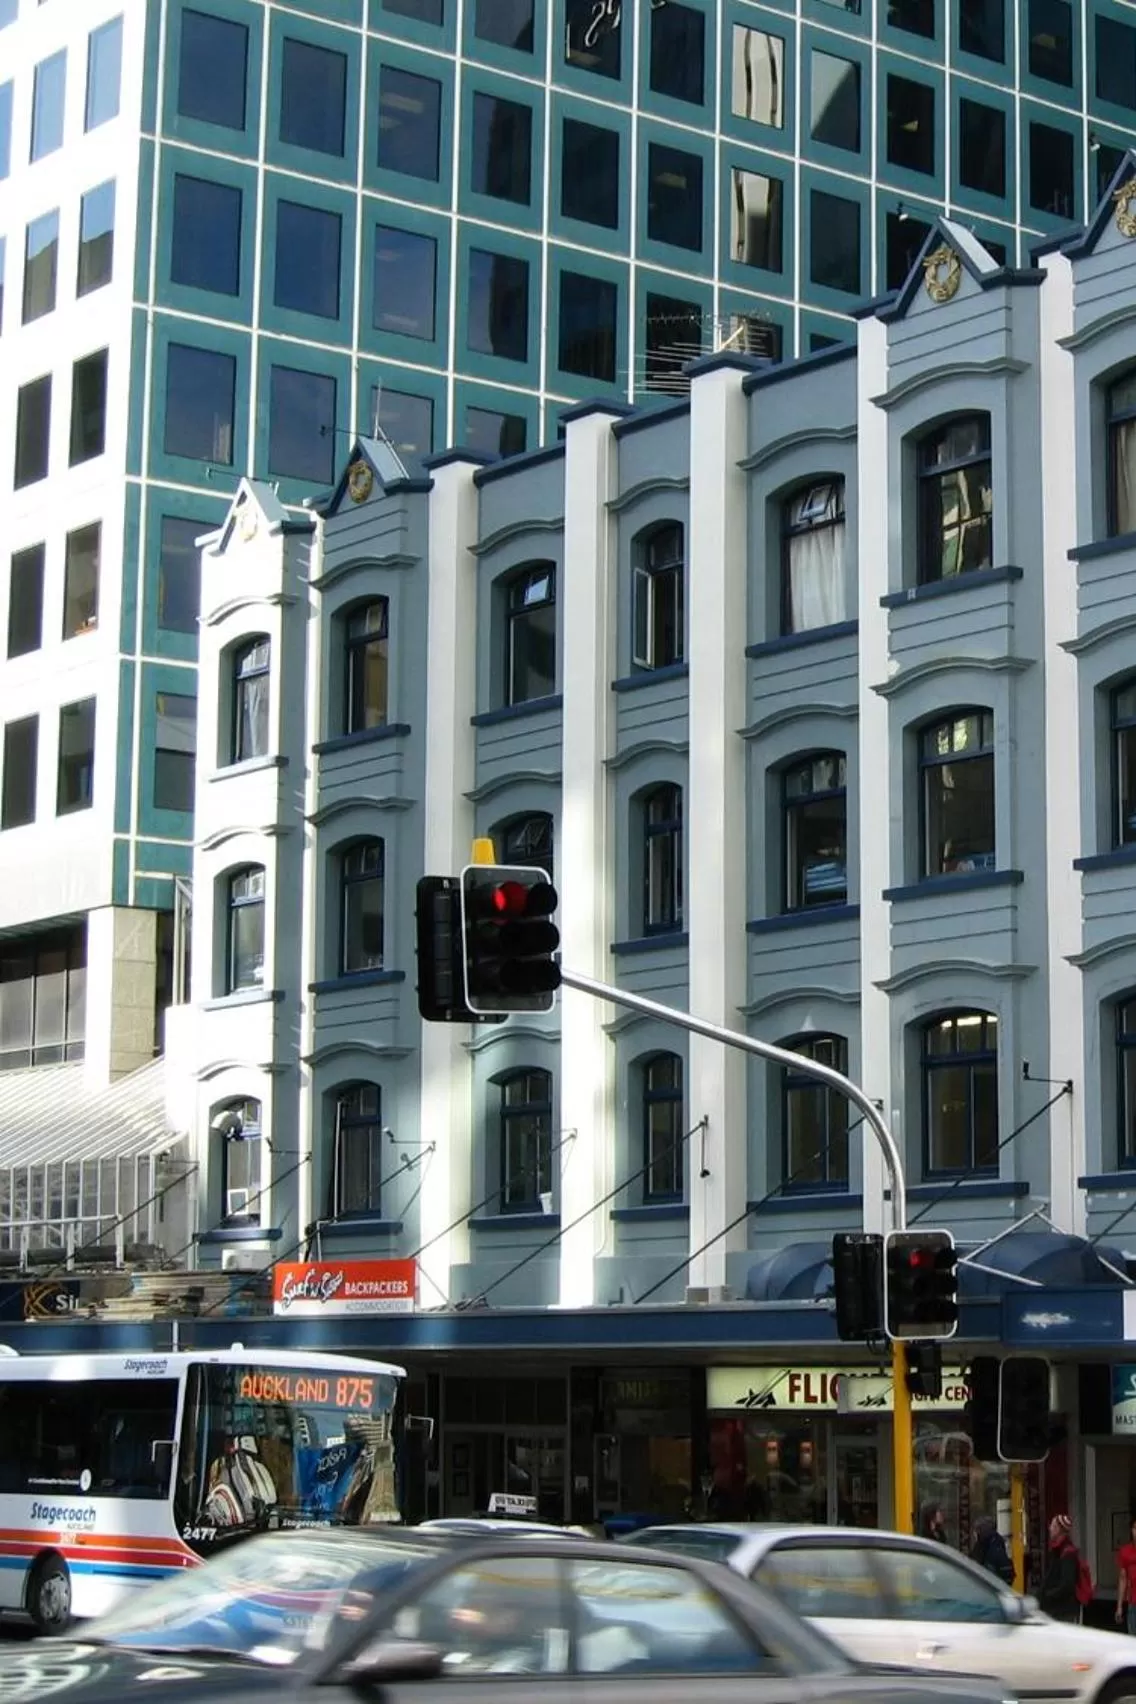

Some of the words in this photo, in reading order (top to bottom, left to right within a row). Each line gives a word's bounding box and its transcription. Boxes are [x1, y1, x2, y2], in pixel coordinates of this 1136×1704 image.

[345, 1281, 408, 1295] BACKPACKERS
[240, 1376, 329, 1402] AUCKLAND
[335, 1378, 374, 1408] 875
[30, 1502, 96, 1524] Stagecoach
[183, 1527, 217, 1540] 2477
